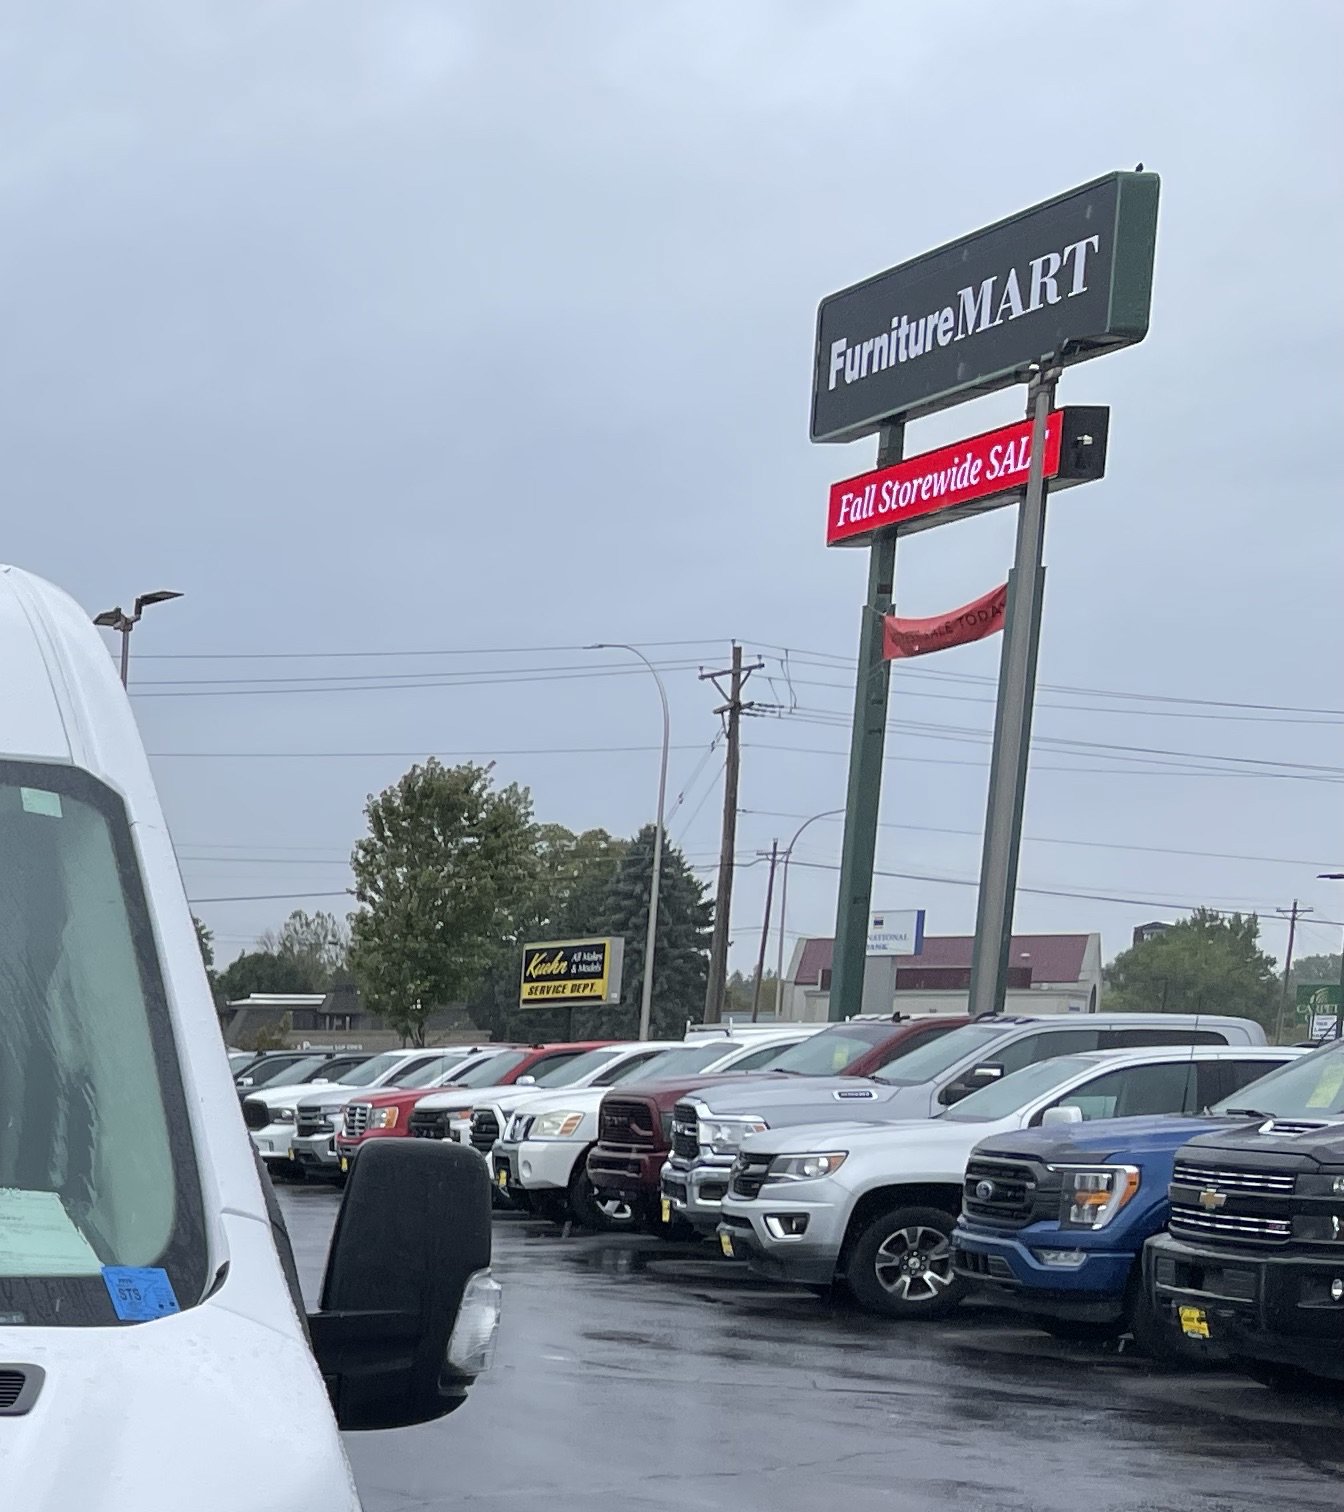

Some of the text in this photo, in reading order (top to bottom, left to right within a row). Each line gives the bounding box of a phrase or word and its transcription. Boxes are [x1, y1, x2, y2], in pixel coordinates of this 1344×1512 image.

[828, 234, 1100, 391] FurnitureMART
[837, 430, 1050, 527] Fall Storewide SAL
[526, 950, 568, 979] Kuehn
[528, 983, 569, 996] SERVICE
